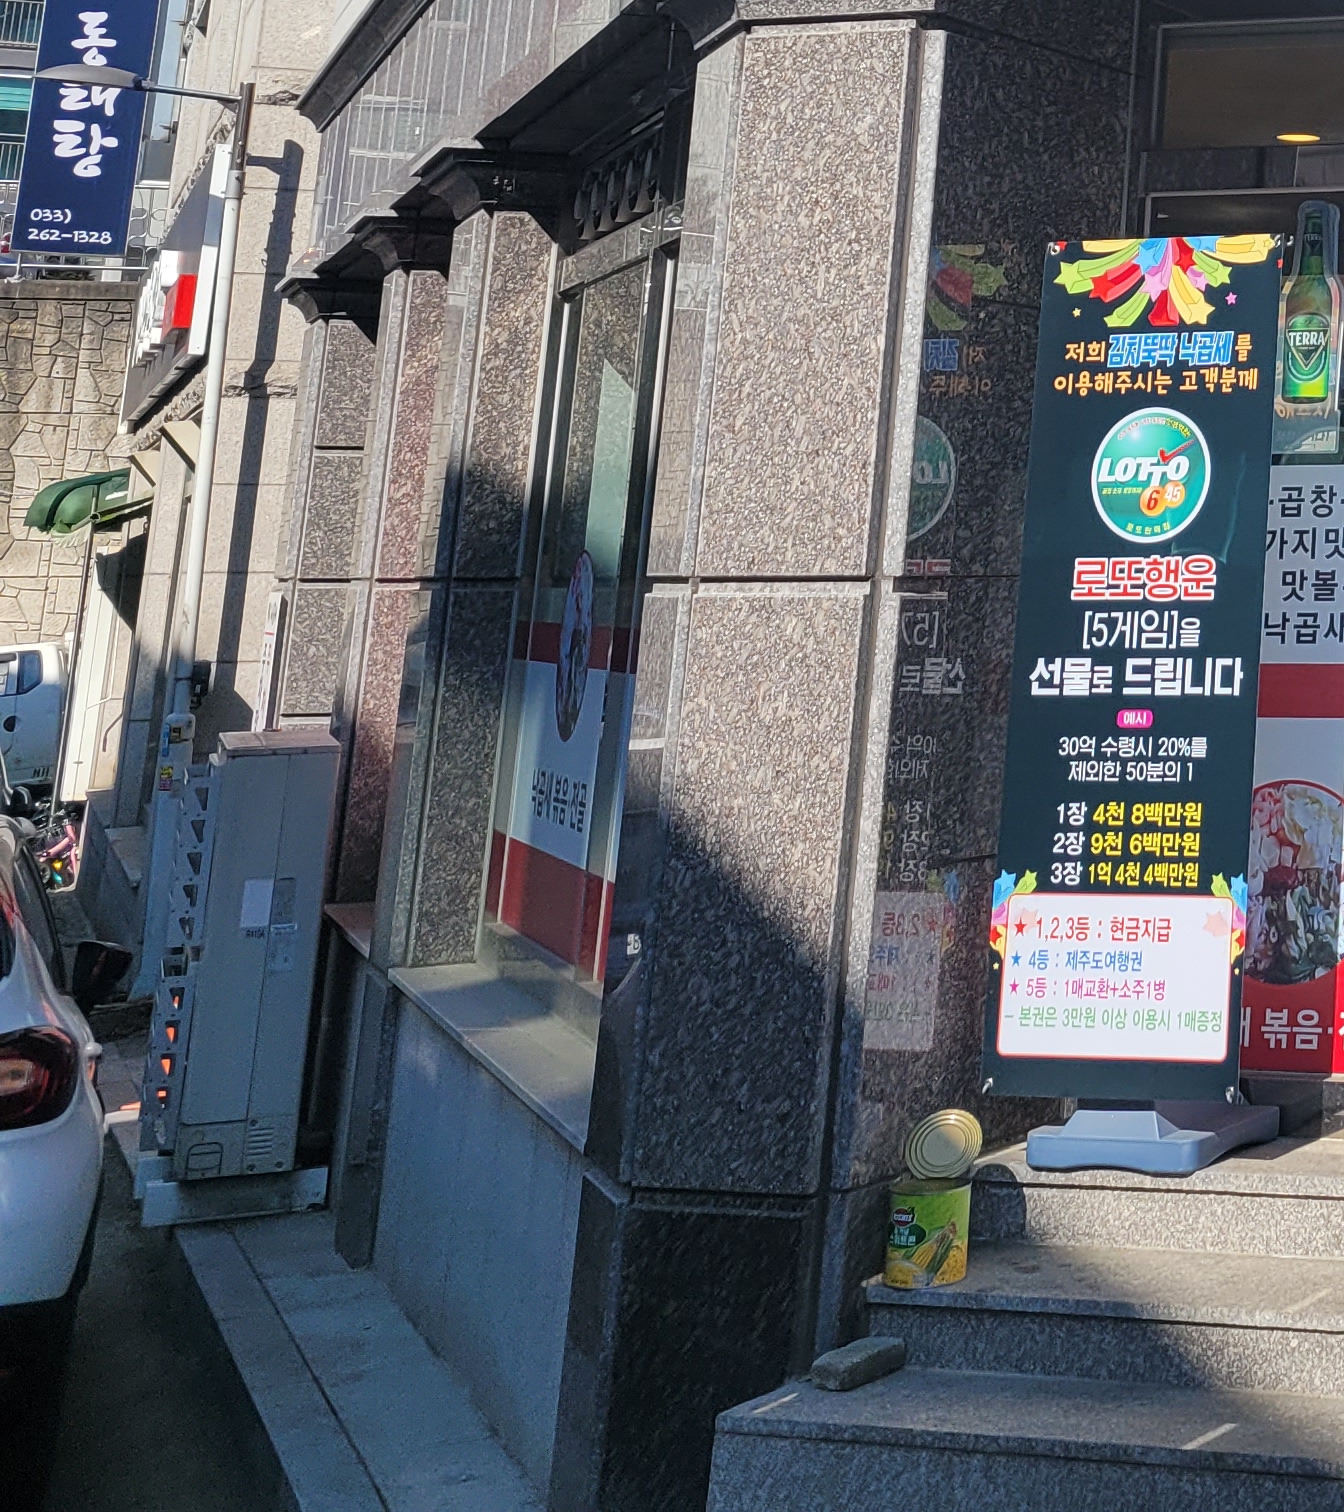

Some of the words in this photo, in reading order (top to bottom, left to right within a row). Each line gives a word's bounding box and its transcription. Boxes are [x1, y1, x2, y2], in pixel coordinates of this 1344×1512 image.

[30, 207, 72, 225] 033)
[28, 227, 112, 245] 262-1328
[1065, 341, 1105, 362] 저희
[1107, 333, 1178, 368] 김치뚝딱
[1288, 331, 1326, 346] TERRA
[1054, 369, 1172, 396] 이용해주시는
[1180, 367, 1258, 393] 고객분께
[1098, 456, 1189, 488] LOTTO
[1071, 555, 1216, 601] 로또행운
[1083, 610, 1200, 649] [5게임]을
[1029, 658, 1112, 696] 선물로
[1123, 657, 1243, 696] 드립니다
[1123, 712, 1146, 725] 예시
[1059, 736, 1096, 757] 30억
[1101, 736, 1152, 757] 수령시
[1158, 736, 1207, 757] 20%를
[1068, 761, 1121, 782] 제외한
[1126, 761, 1180, 782] 50분의
[1187, 762, 1193, 781] 1
[1057, 801, 1087, 826] 1장
[1092, 801, 1125, 826] 4천
[1131, 802, 1202, 827] 8백만원
[1053, 831, 1085, 856] 2장
[1090, 831, 1123, 856] 9천
[1130, 832, 1200, 857] 6백만원
[1050, 861, 1083, 886] 3장
[1089, 862, 1112, 886] 1억
[1115, 861, 1140, 886] 4천
[1144, 862, 1199, 887] 4백만원
[1110, 916, 1172, 943] 현금지급
[1028, 949, 1049, 971] 4등
[1065, 950, 1143, 972] 제주도여행권
[1026, 977, 1047, 998] 5등
[1018, 1005, 1057, 1028] 본권은
[1062, 1007, 1096, 1028] 3만원
[1101, 1007, 1128, 1030] 이상
[1133, 1009, 1171, 1031] 이용시
[1177, 1010, 1223, 1033] 1매증정
